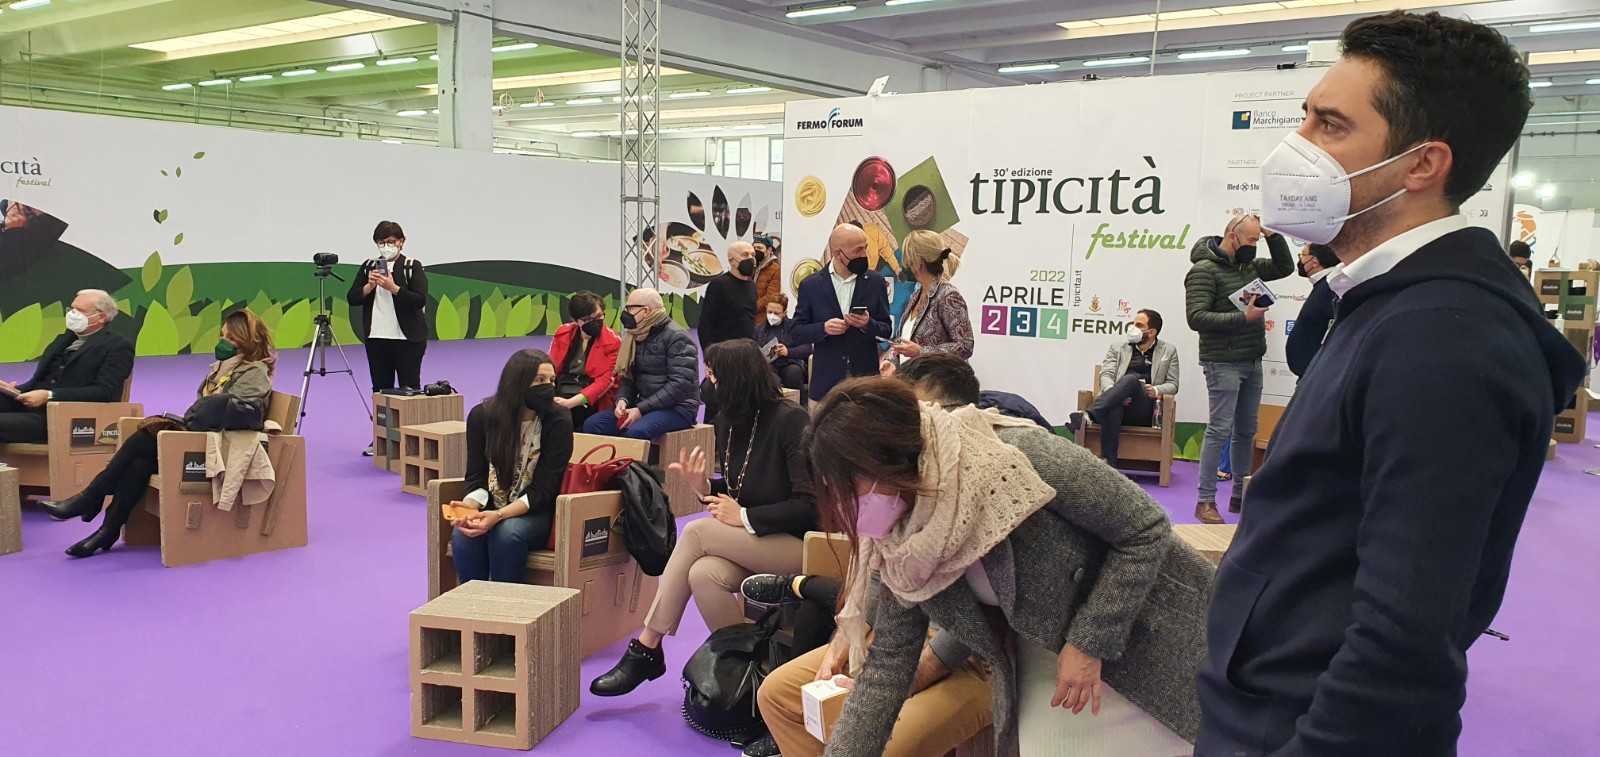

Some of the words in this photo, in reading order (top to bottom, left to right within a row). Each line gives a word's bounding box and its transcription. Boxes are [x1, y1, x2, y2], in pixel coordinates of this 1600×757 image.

[797, 120, 827, 130] FERMO
[831, 118, 863, 129] FORUM
[1253, 115, 1300, 126] Marchigiano
[1011, 167, 1053, 177] edizione
[1085, 223, 1191, 260] festival
[1030, 270, 1066, 283] 2022
[982, 285, 1065, 307] APRILE
[987, 309, 1001, 331] 2
[1016, 311, 1031, 333] 3
[1047, 313, 1061, 336] 4
